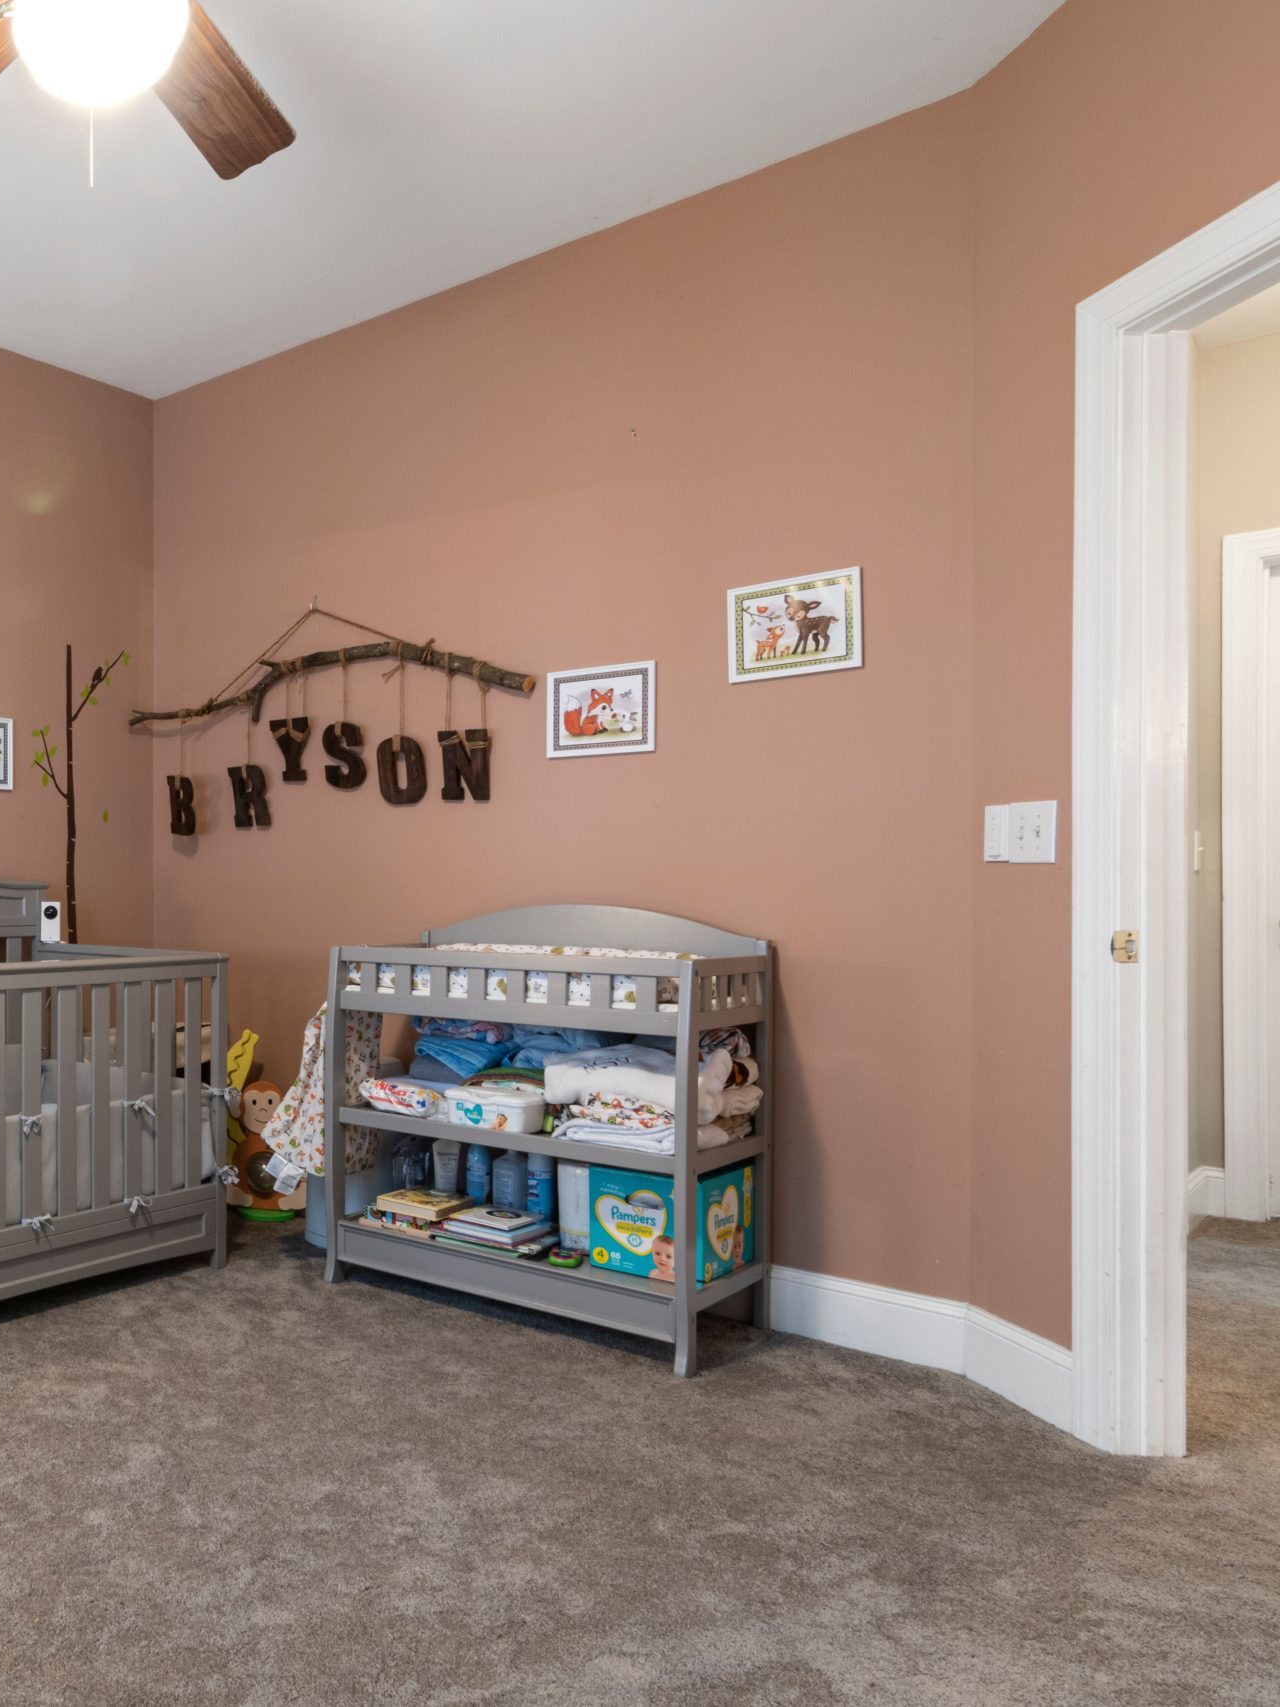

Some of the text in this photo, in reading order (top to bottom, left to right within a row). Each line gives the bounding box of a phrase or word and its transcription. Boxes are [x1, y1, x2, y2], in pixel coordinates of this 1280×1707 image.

[167, 716, 491, 836] BRYSON
[611, 1205, 656, 1227] Pampers
[714, 1214, 735, 1232] Pampers
[616, 1223, 653, 1236] swaddlers
[597, 1249, 604, 1258] 4
